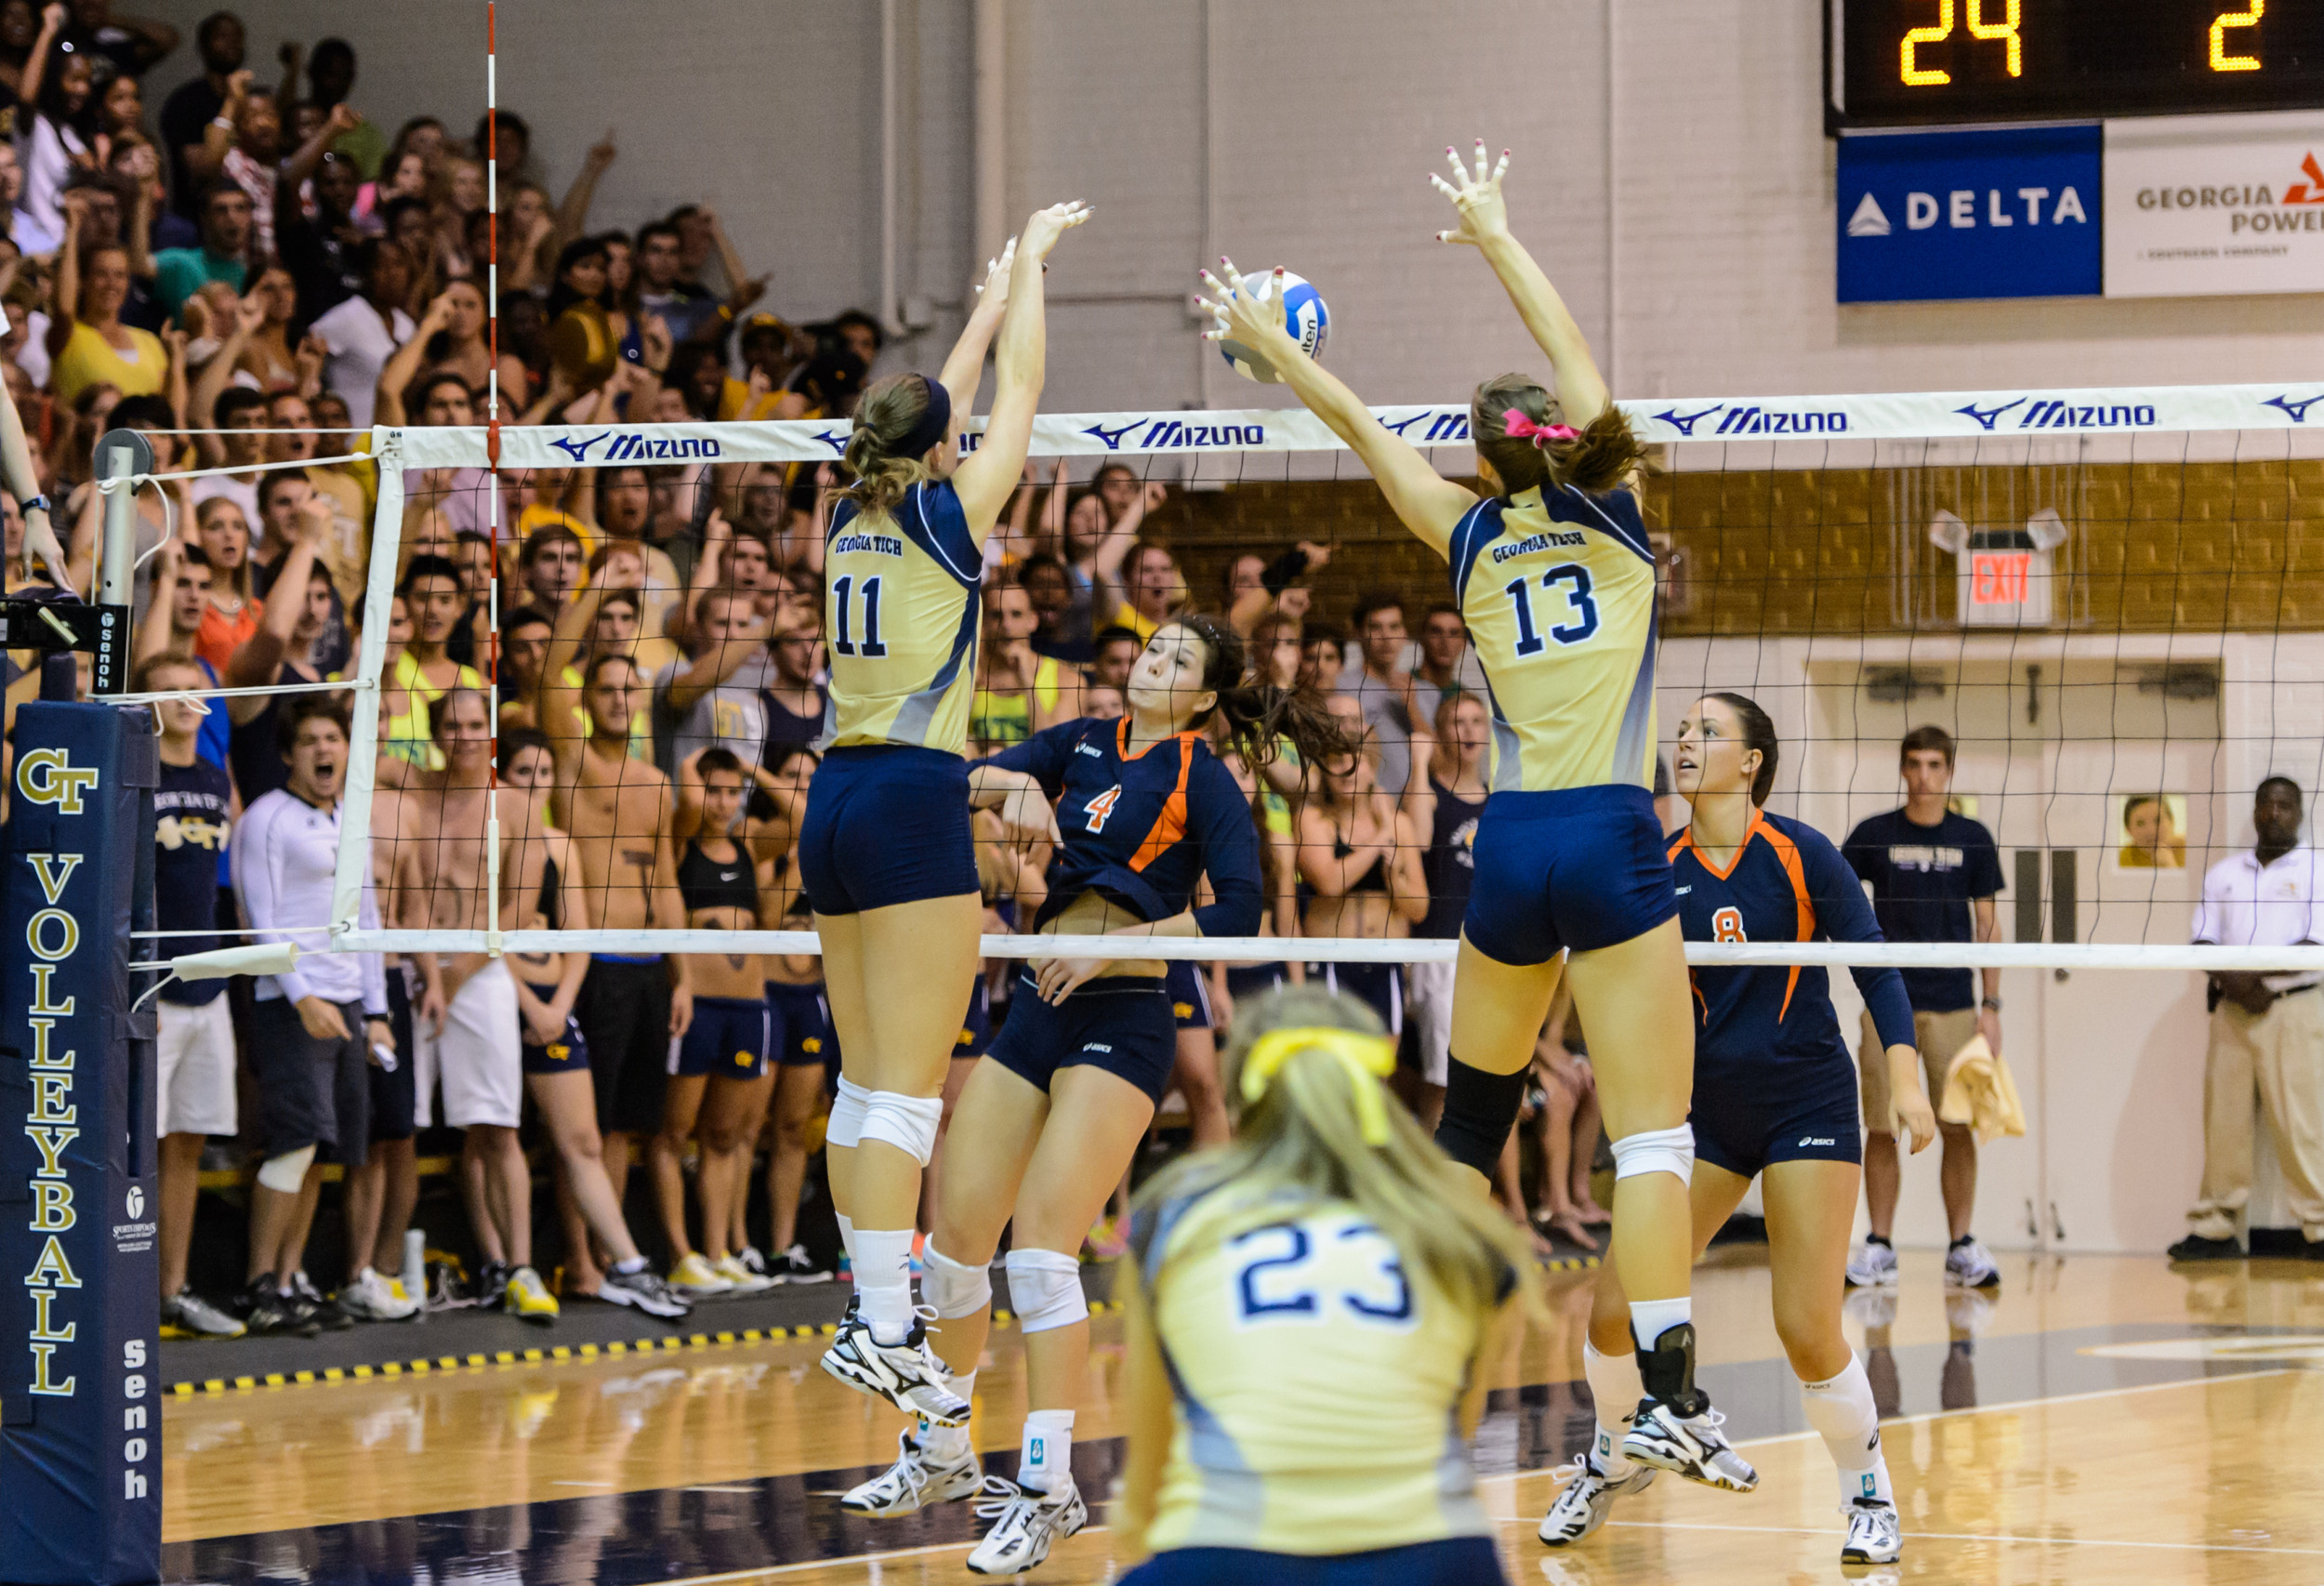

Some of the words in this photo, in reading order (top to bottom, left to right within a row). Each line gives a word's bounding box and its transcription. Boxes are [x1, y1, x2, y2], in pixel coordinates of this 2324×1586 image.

[1900, 0, 2021, 86] 24
[2209, 0, 2265, 72] 2
[1905, 186, 2088, 230] DELTA
[2136, 184, 2275, 210] GEORGIA
[2231, 210, 2324, 234] POWE
[835, 535, 872, 555] GEORGIA
[873, 535, 903, 557] TECH
[1492, 534, 1548, 564] GEORGIA
[1548, 531, 1587, 548] TECH
[1972, 554, 2032, 604] EXIT
[831, 574, 888, 658] 11
[1504, 562, 1602, 660] 13
[17, 747, 99, 814] GT
[1083, 784, 1122, 834] 4
[1711, 905, 1748, 943] 8
[25, 853, 84, 1396] VOLLEYBALL
[1223, 1216, 1419, 1329] 23
